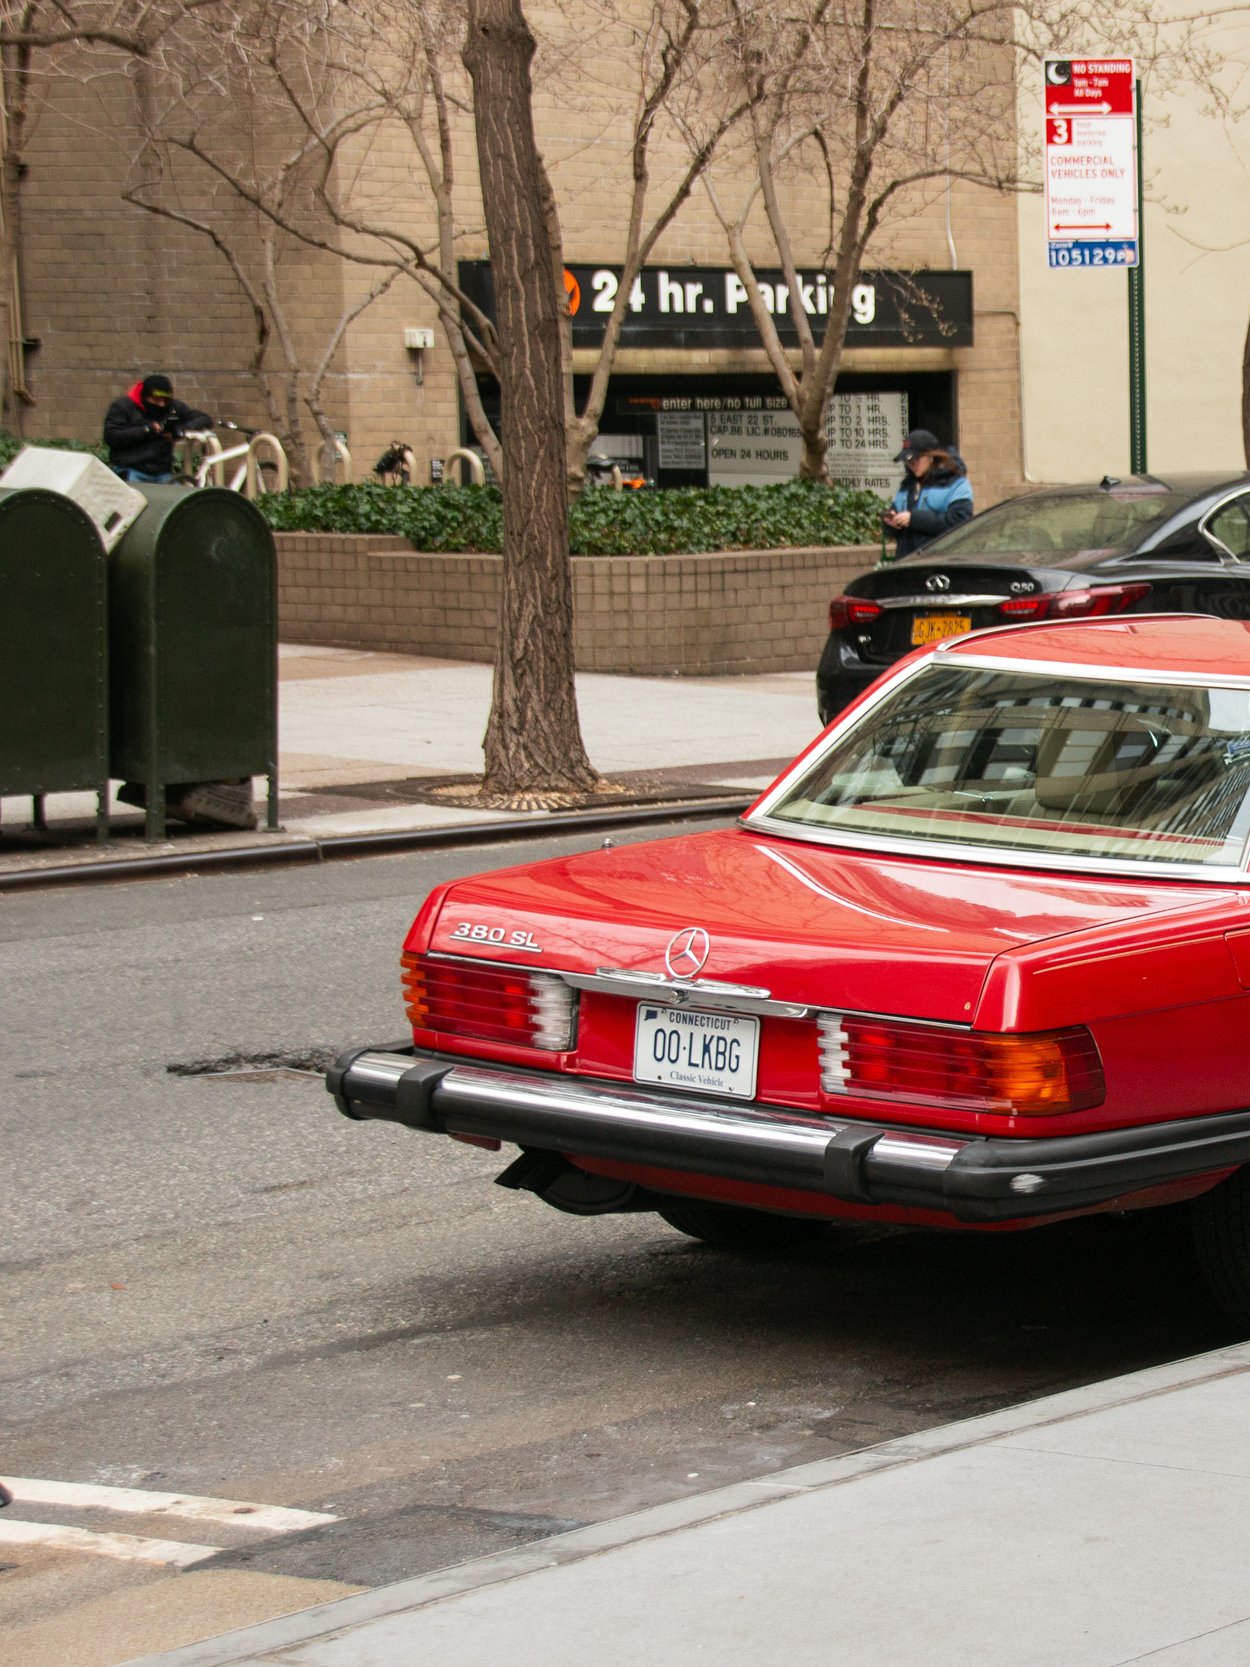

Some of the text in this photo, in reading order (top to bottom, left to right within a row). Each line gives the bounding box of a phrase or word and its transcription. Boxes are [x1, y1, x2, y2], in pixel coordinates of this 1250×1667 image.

[1073, 63, 1131, 74] NO STANDING
[1085, 88, 1102, 99] Days
[1052, 120, 1069, 145] 3
[1050, 155, 1114, 166] COMMERCIAL
[1051, 168, 1126, 179] VEHICLES ONLY
[1051, 196, 1082, 206] Monday
[1089, 195, 1115, 205] Friday
[1051, 208, 1070, 216] 8am
[1049, 248, 1116, 266] 105129
[656, 270, 714, 314] hr.
[662, 398, 692, 410] enter
[696, 396, 741, 410] here/no
[745, 396, 762, 410] full
[766, 397, 788, 409] size
[840, 404, 851, 414] TO
[719, 414, 743, 425] EAST
[747, 414, 759, 425] 22
[763, 415, 777, 425] ST.
[840, 416, 852, 426] TO
[840, 428, 852, 438] TO
[840, 440, 852, 449] TO
[711, 449, 789, 461] OPEN 24 HOURS
[864, 478, 890, 488] RATES
[454, 922, 539, 947] 380 SL
[669, 1011, 731, 1031] CONNECTICUT
[670, 1070, 724, 1087] Classic Vehicle
